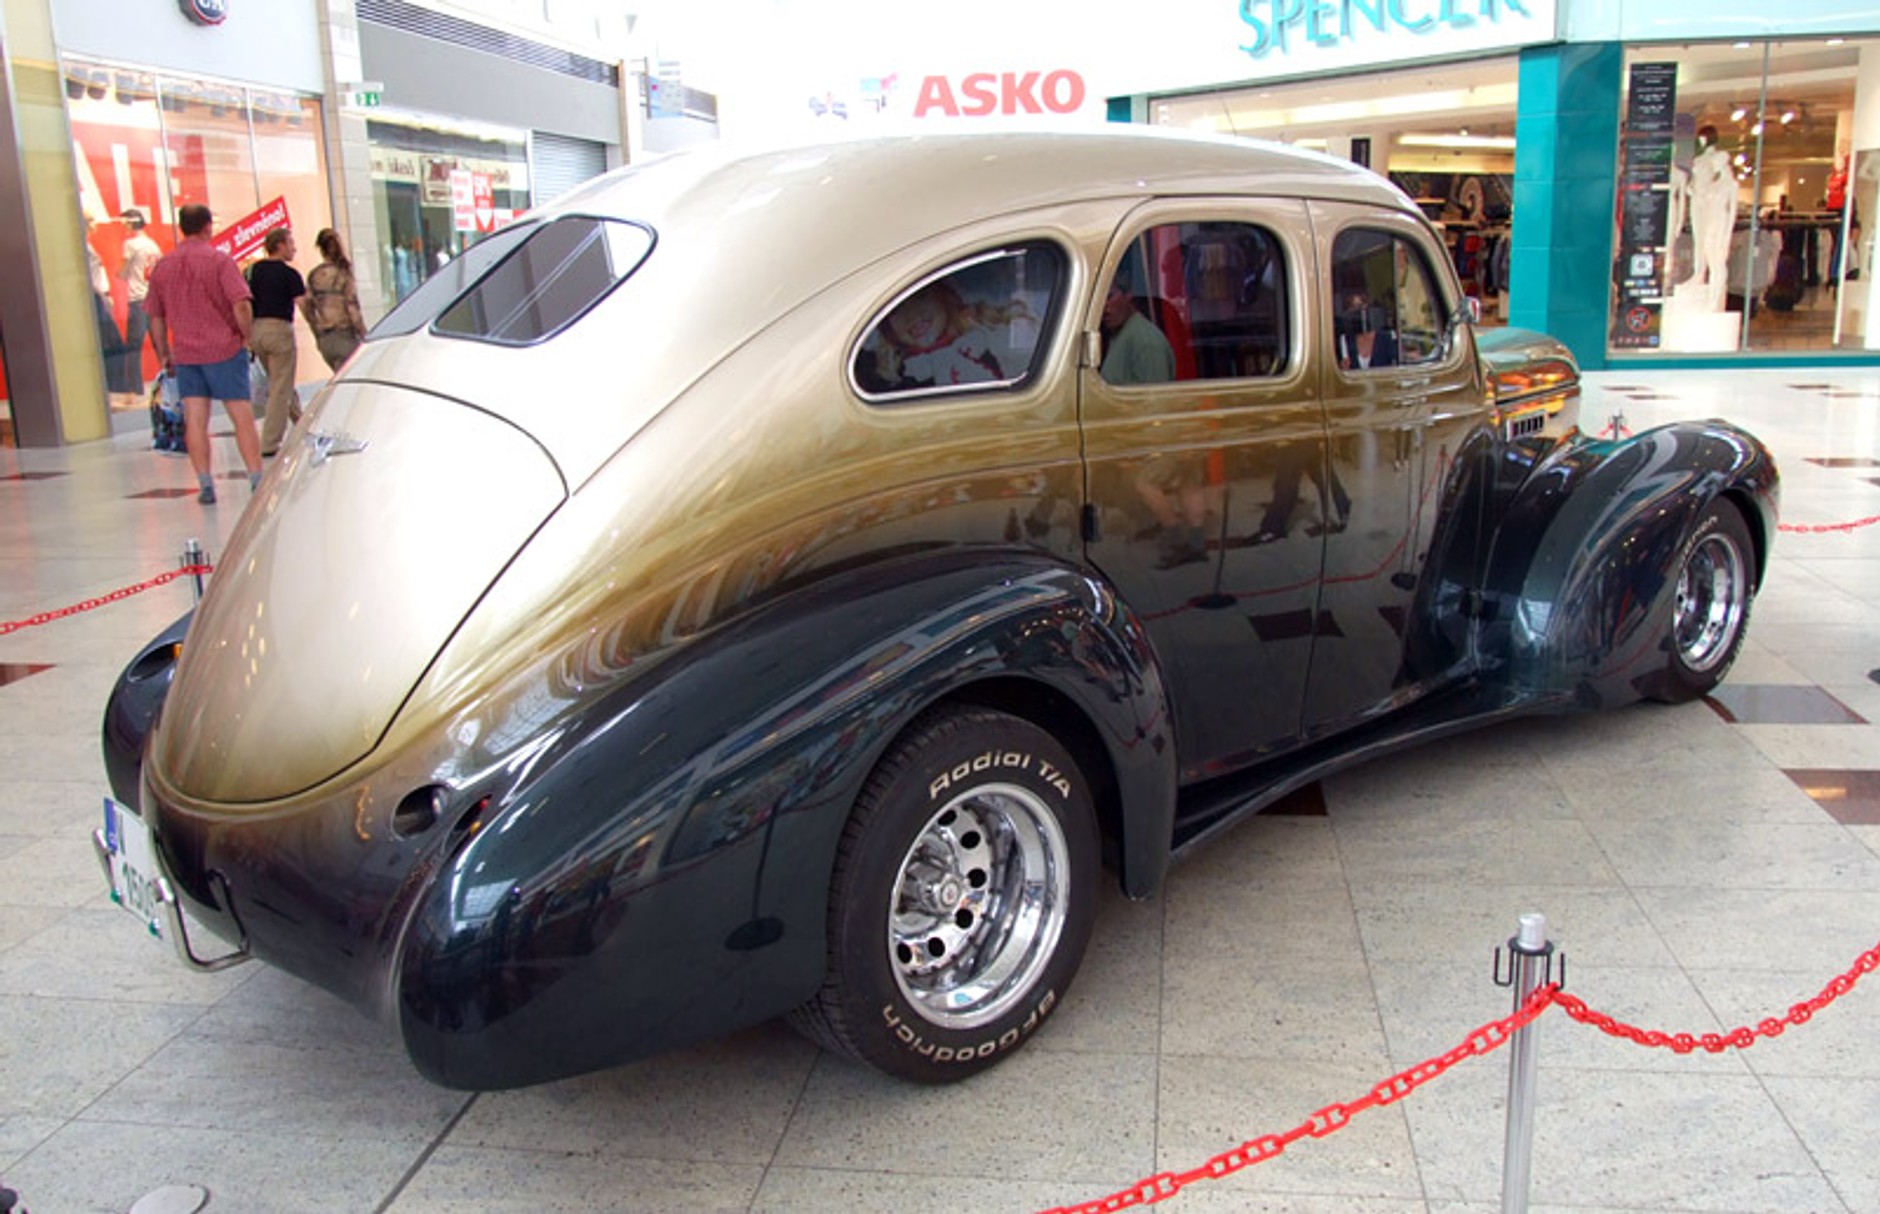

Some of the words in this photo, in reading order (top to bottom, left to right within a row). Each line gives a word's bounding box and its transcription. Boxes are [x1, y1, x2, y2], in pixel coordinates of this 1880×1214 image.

[913, 69, 1086, 118] ASKO
[929, 751, 1031, 799] Radial
[1039, 760, 1071, 799] T/A
